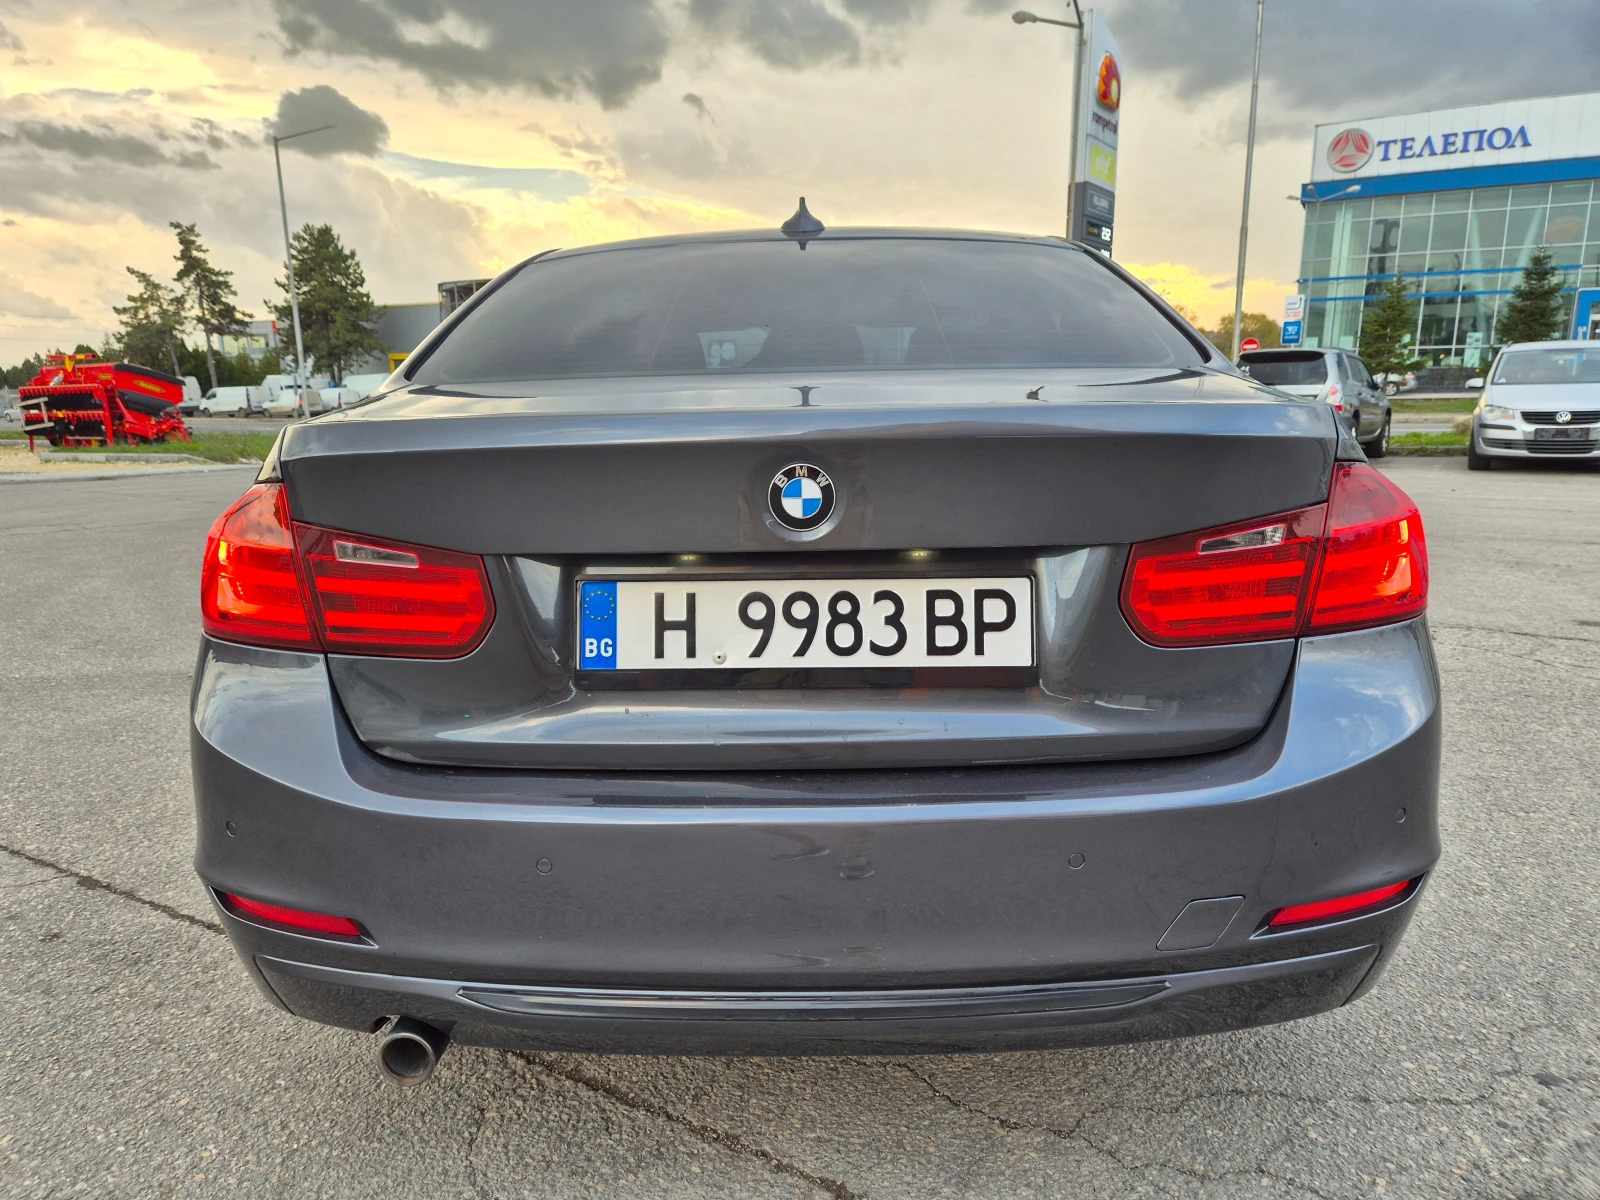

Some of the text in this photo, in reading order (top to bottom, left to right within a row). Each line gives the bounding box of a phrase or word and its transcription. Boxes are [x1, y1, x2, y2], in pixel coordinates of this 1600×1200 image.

[1376, 124, 1532, 162] ТЕЛЕПОЛ
[774, 465, 830, 488] BMW
[654, 588, 1017, 659] H 9983 BP
[584, 637, 613, 658] BG
